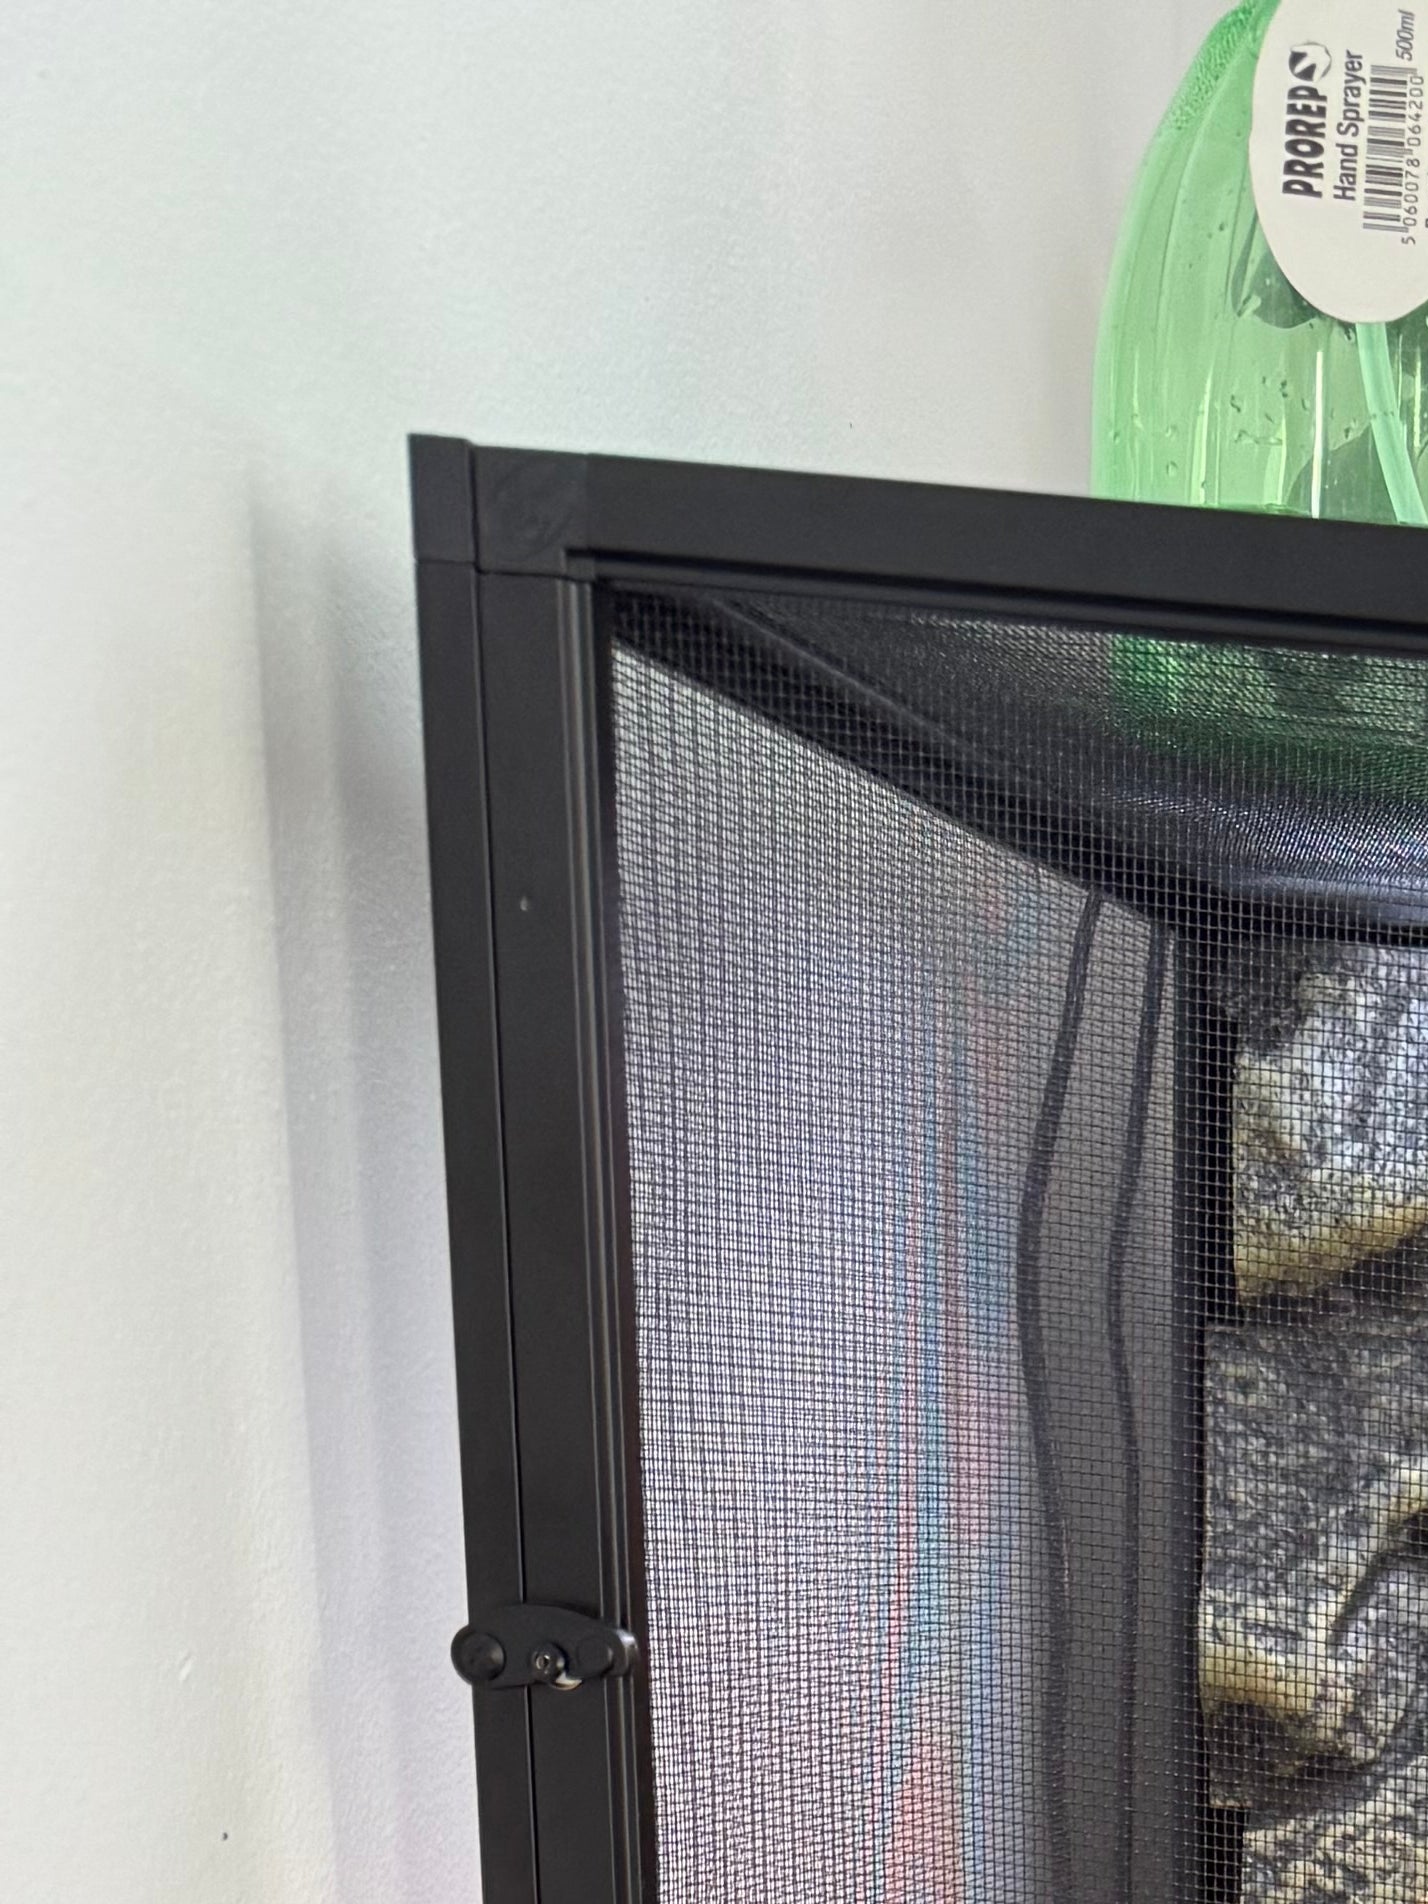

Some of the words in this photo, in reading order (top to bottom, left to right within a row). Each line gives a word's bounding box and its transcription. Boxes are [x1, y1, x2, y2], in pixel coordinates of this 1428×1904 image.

[1395, 8, 1416, 62] 500ml
[1337, 49, 1367, 138] Sprayer
[1282, 85, 1328, 199] PROREP
[1333, 143, 1359, 201] Hand
